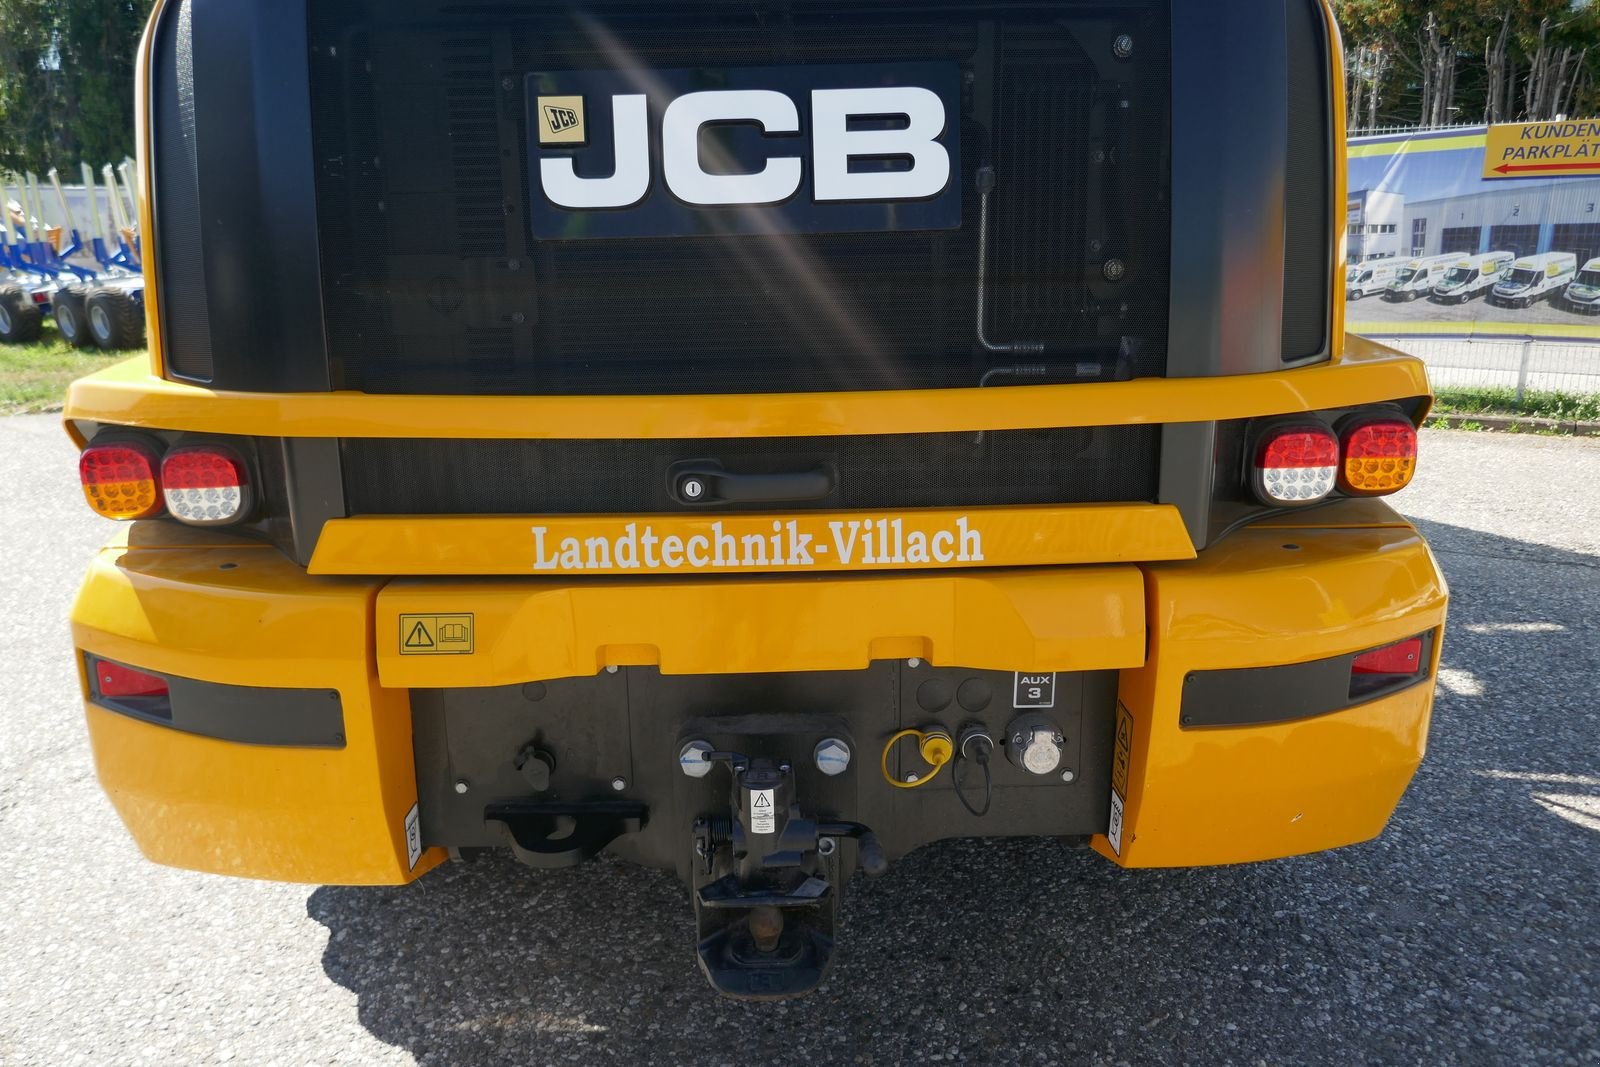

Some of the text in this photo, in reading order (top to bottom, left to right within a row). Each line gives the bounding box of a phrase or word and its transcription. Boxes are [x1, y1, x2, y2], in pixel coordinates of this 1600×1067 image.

[549, 108, 577, 131] JCB
[1521, 123, 1600, 139] KUNDEN
[539, 86, 951, 208] JCB
[1502, 139, 1600, 160] PARKPLÄT
[1512, 206, 1520, 217] 2
[1585, 203, 1595, 213] 3
[532, 515, 984, 570] Landtechnik-Villach
[1020, 676, 1050, 685] AUX
[1028, 687, 1041, 699] 3
